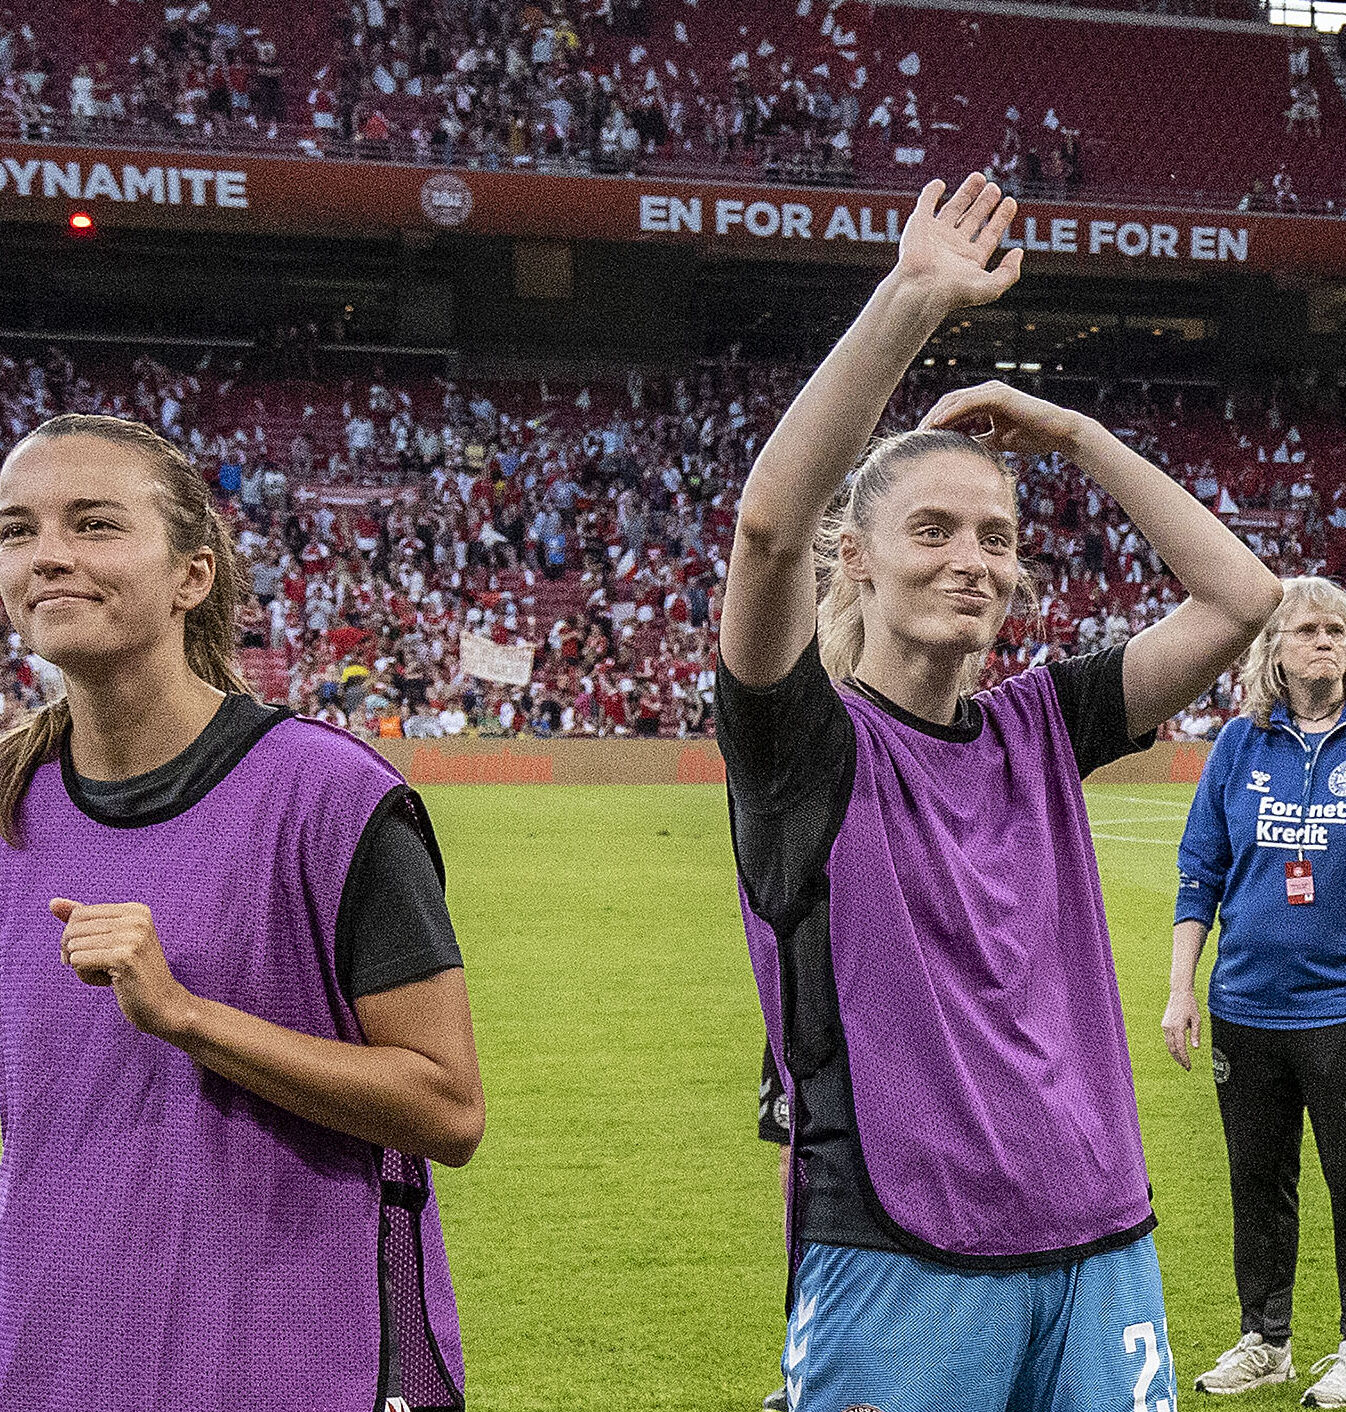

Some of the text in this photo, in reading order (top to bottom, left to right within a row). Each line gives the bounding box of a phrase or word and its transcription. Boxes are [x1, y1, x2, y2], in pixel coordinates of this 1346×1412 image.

[0, 158, 248, 208] YNAMITE
[639, 195, 702, 233] EN
[715, 199, 812, 239] FOR
[1000, 217, 1078, 252] LLE
[1089, 220, 1179, 259] FOR
[1191, 226, 1249, 261] EN
[1256, 820, 1328, 844] Kredit
